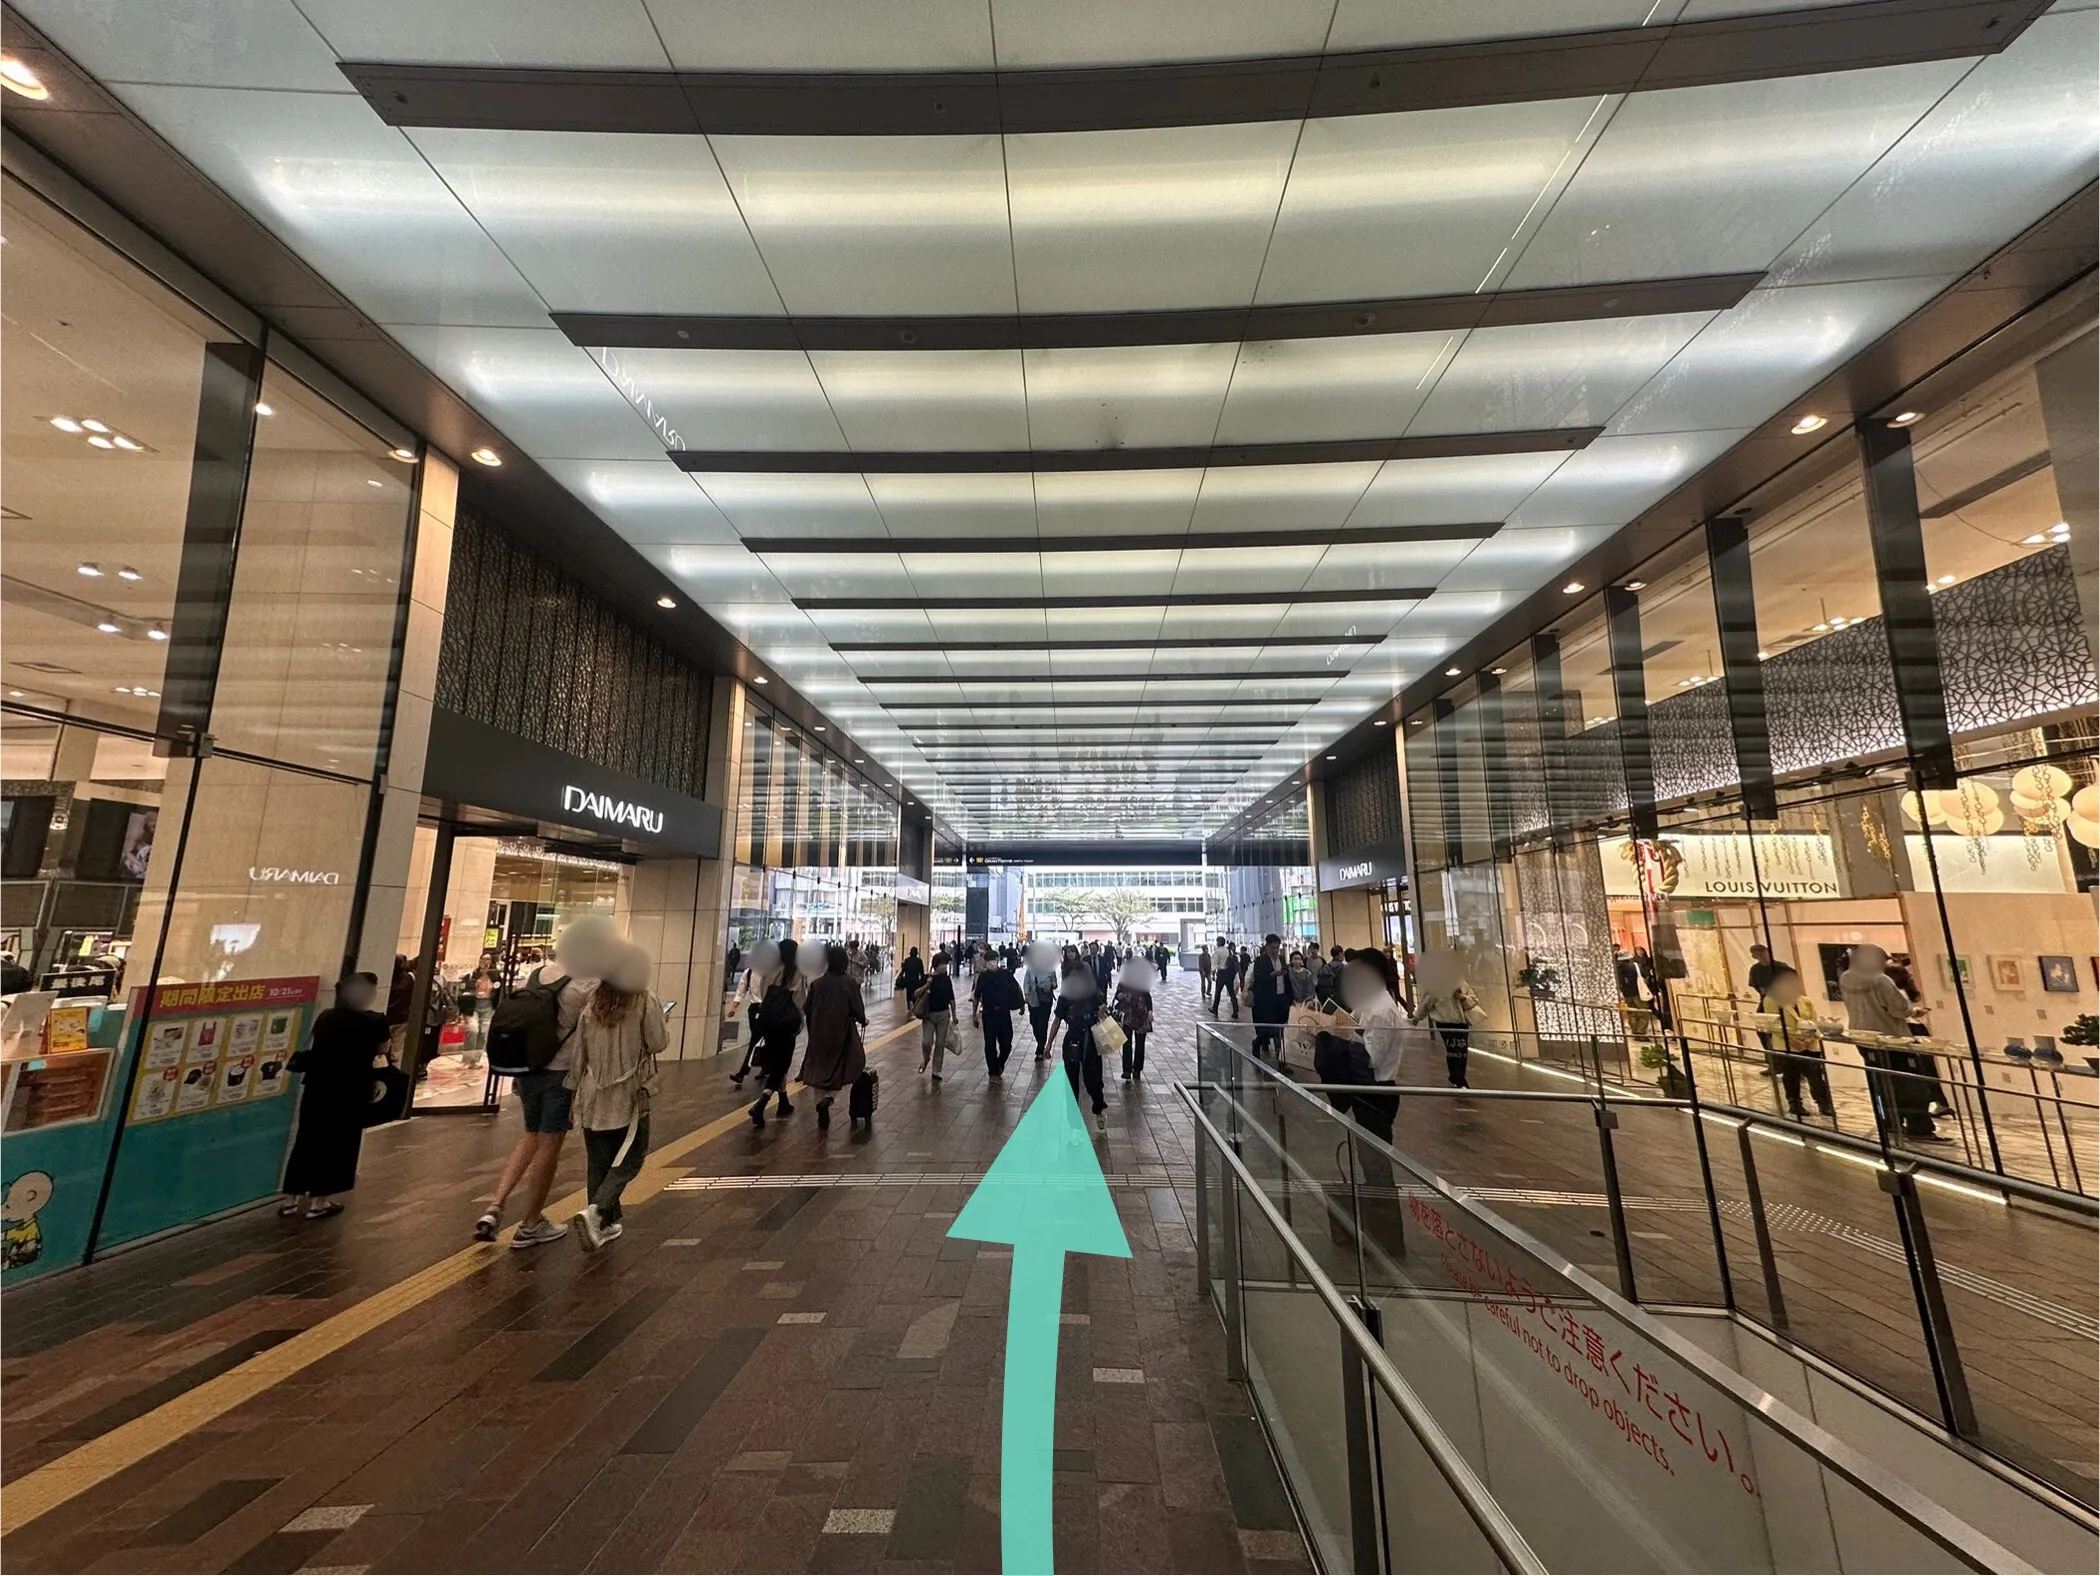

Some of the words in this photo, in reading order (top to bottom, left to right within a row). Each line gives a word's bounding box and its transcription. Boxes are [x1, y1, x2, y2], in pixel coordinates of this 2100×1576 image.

[563, 785, 664, 834] DAIMARU
[1339, 861, 1373, 881] DAIMARU
[1705, 880, 1755, 893] LOUIS
[1758, 881, 1837, 894] VUITTON
[160, 984, 266, 1008] 期間限定出店
[1523, 1328, 1545, 1359] not
[1546, 1345, 1561, 1373] to
[1564, 1361, 1600, 1409] drop
[1603, 1399, 1675, 1477] objects.
